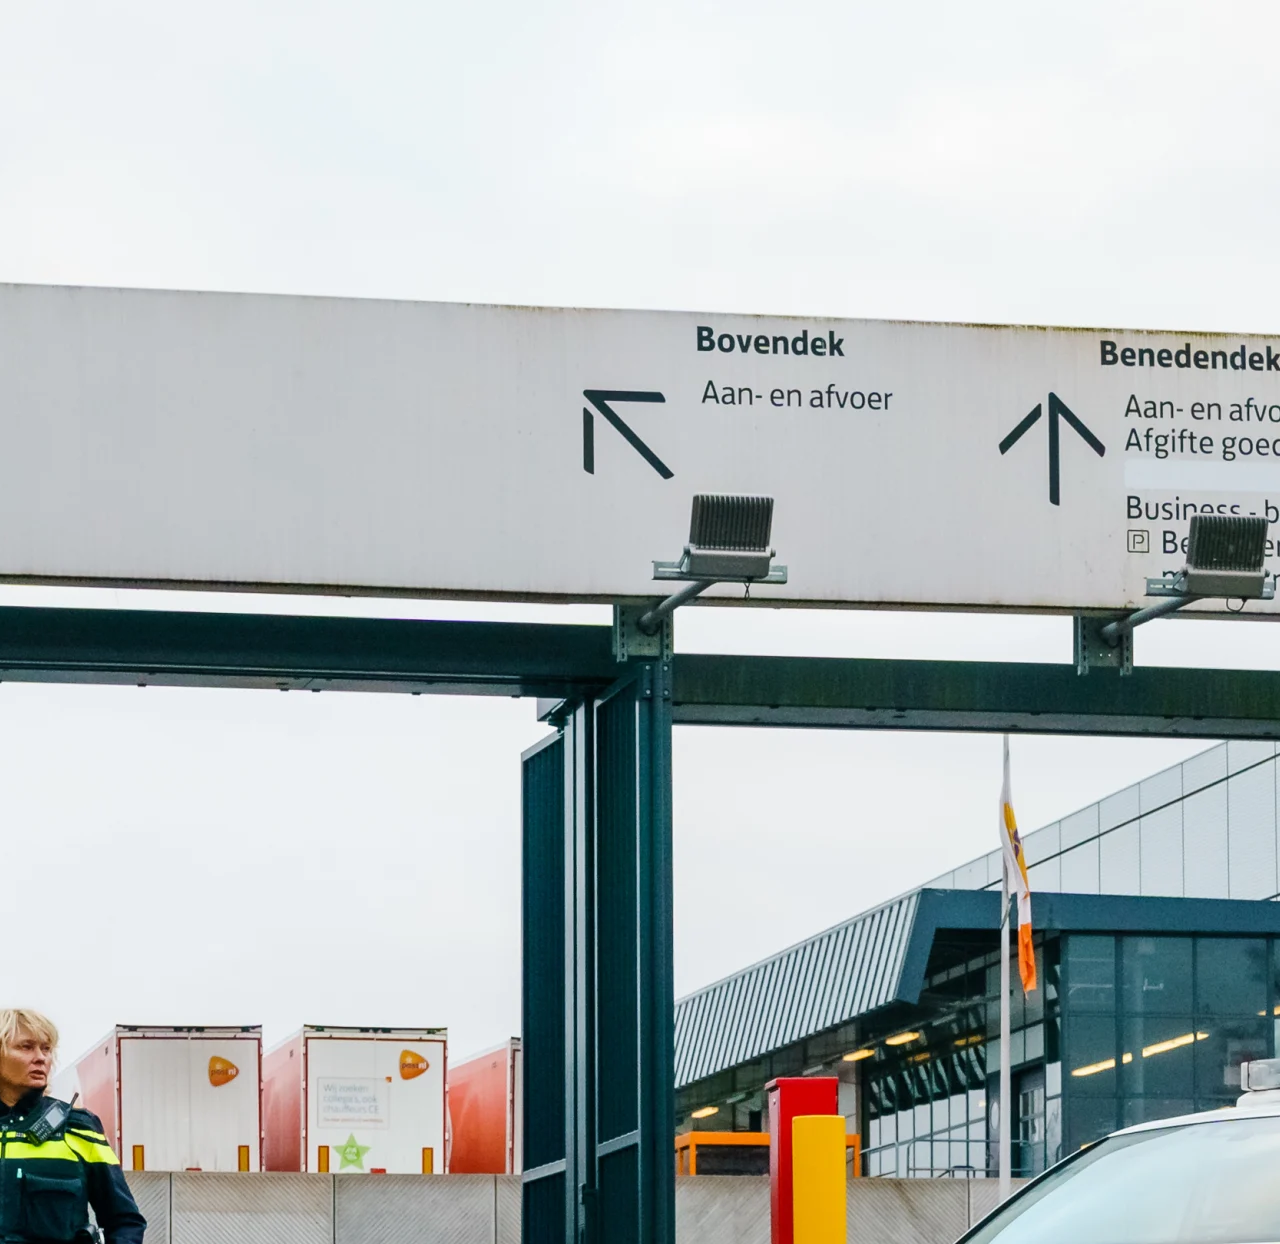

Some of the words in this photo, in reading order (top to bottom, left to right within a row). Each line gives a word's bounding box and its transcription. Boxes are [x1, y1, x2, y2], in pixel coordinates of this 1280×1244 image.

[696, 325, 845, 357] Bovendek
[701, 380, 763, 406] Aan-
[770, 388, 802, 407] en
[809, 383, 893, 411] afvoer
[1124, 393, 1184, 419] Aan-
[1190, 402, 1222, 421] en
[1124, 427, 1214, 460] Afgifte
